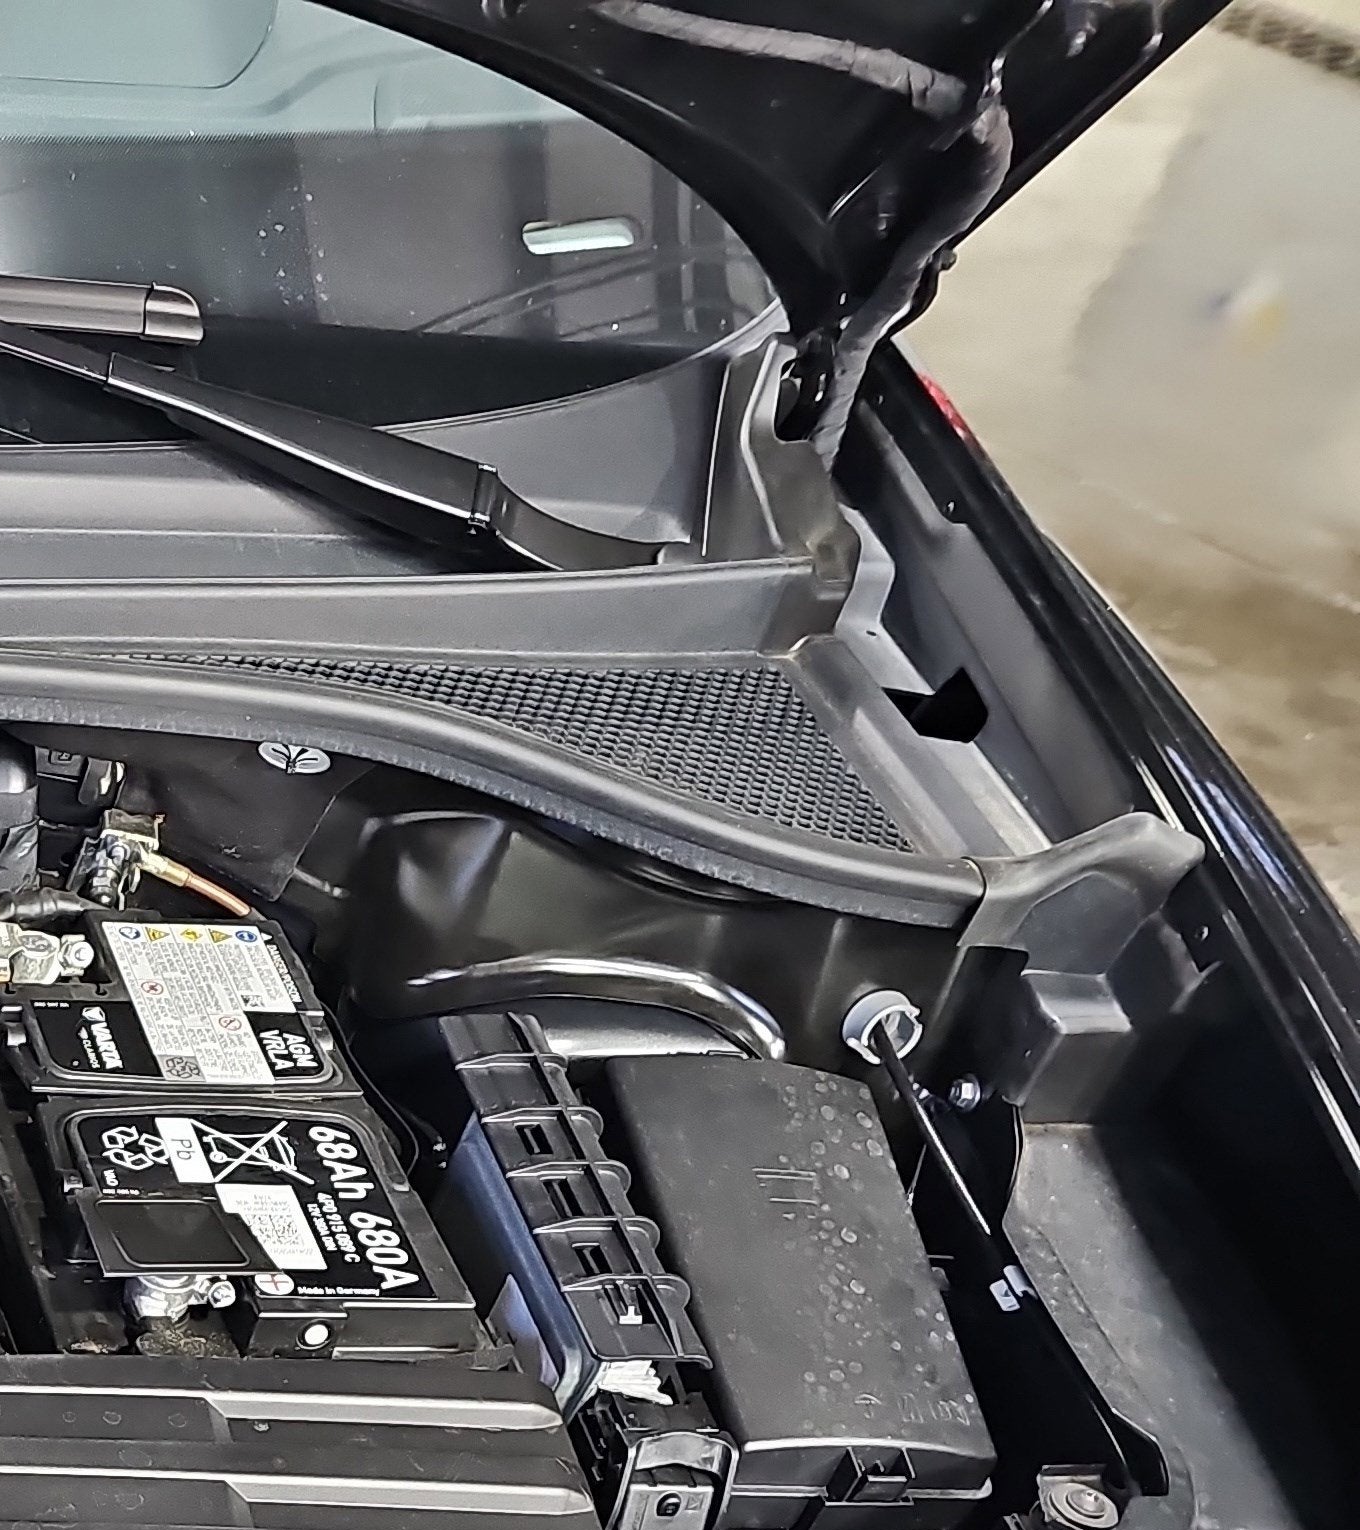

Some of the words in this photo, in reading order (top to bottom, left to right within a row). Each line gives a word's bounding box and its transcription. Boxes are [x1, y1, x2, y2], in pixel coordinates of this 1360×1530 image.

[90, 1022, 123, 1070] VARTA
[259, 1029, 295, 1070] VRLA
[283, 1033, 319, 1067] AGM
[170, 1138, 193, 1161] Pb
[308, 1126, 375, 1199] 68Ah
[349, 1211, 419, 1290] 680A
[344, 1253, 361, 1263] C
[297, 1286, 325, 1295] Made
[325, 1286, 336, 1295] in
[336, 1286, 380, 1297] Germany
